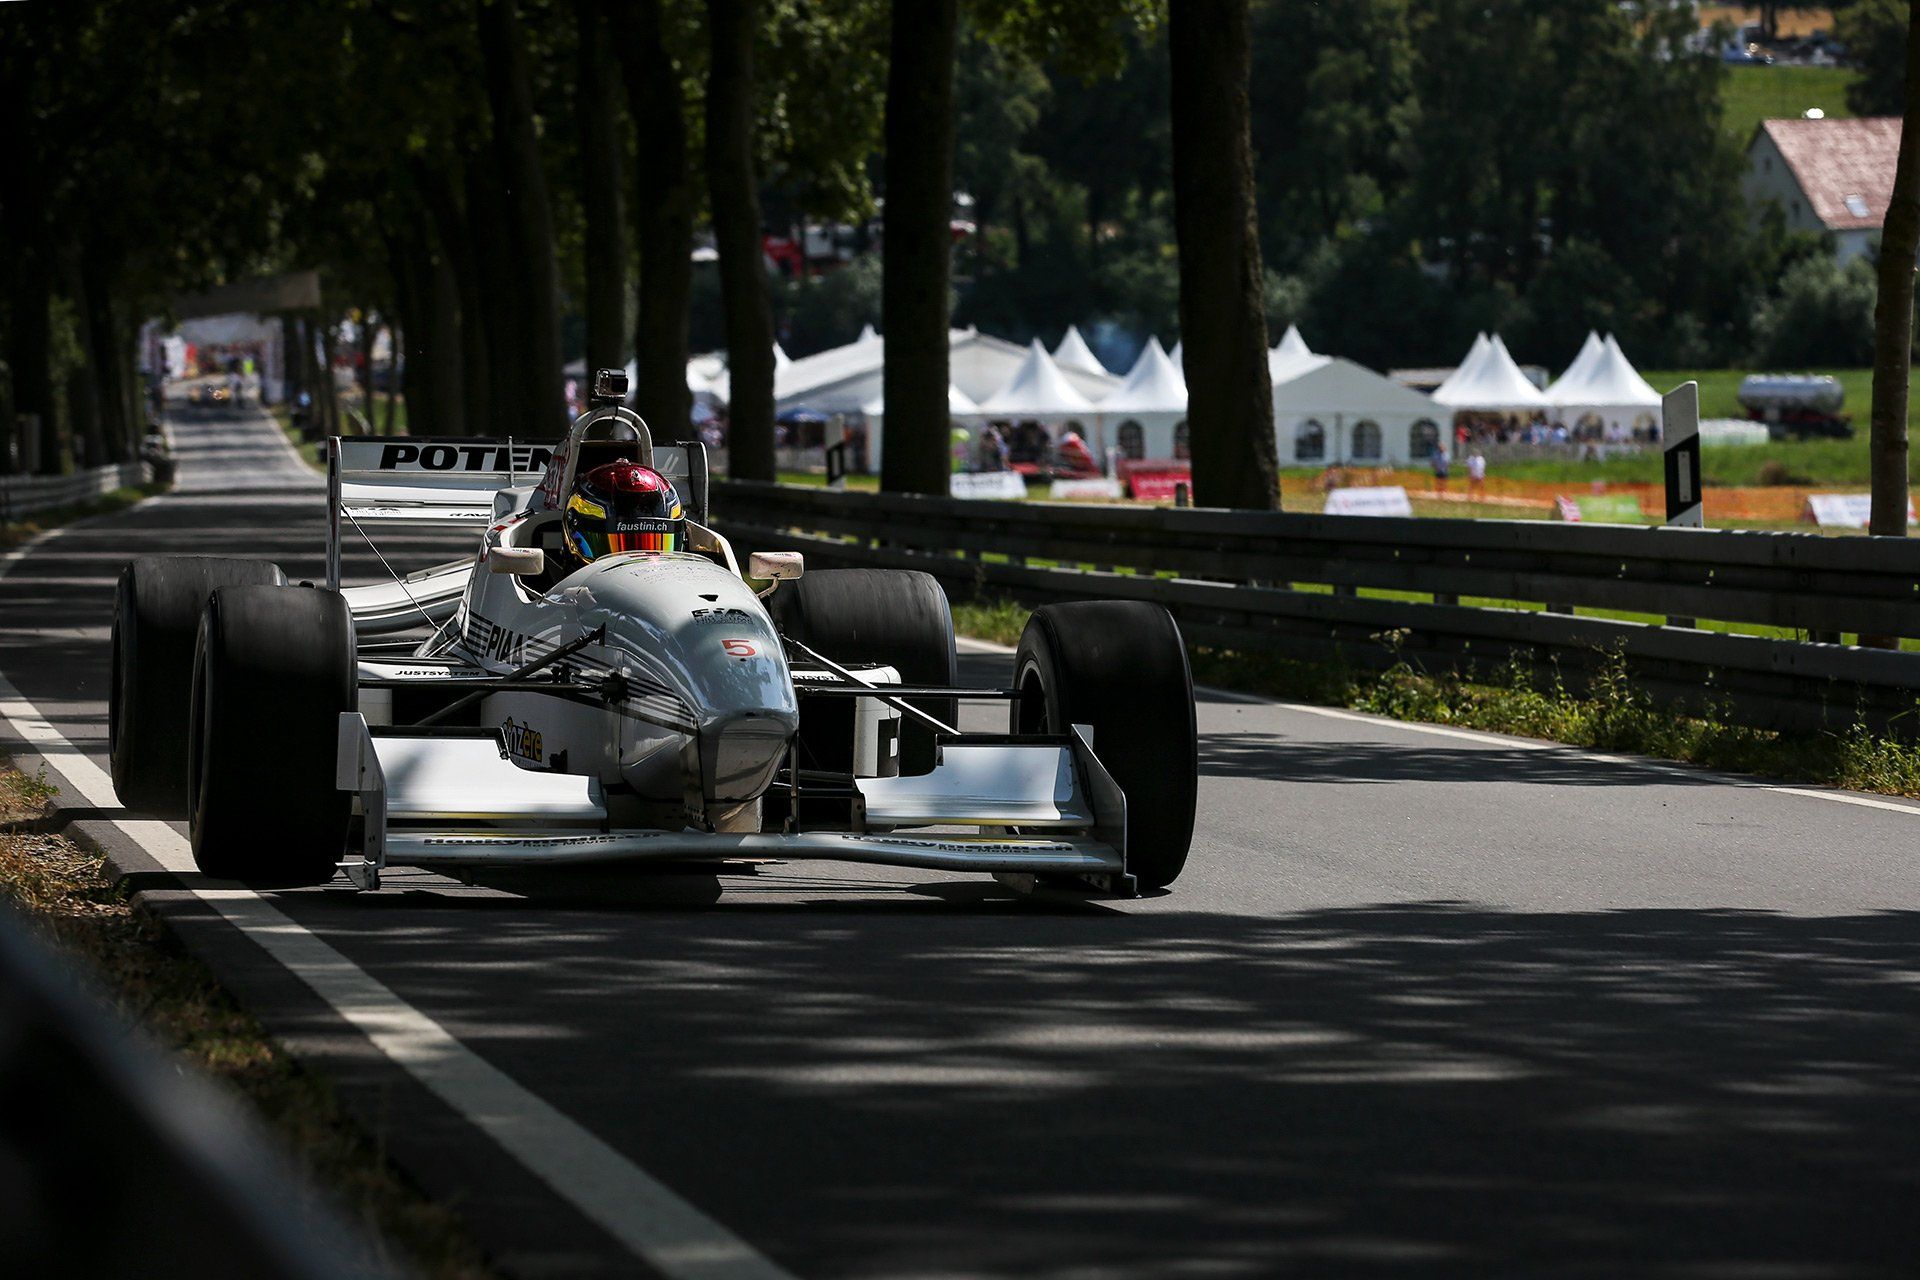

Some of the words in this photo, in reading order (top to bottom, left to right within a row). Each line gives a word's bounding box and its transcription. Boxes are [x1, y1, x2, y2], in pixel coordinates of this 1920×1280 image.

[616, 521, 668, 531] faustini.ch
[485, 623, 524, 668] PIAA
[721, 639, 756, 657] 5
[394, 665, 481, 676] JUSTSYSTEM
